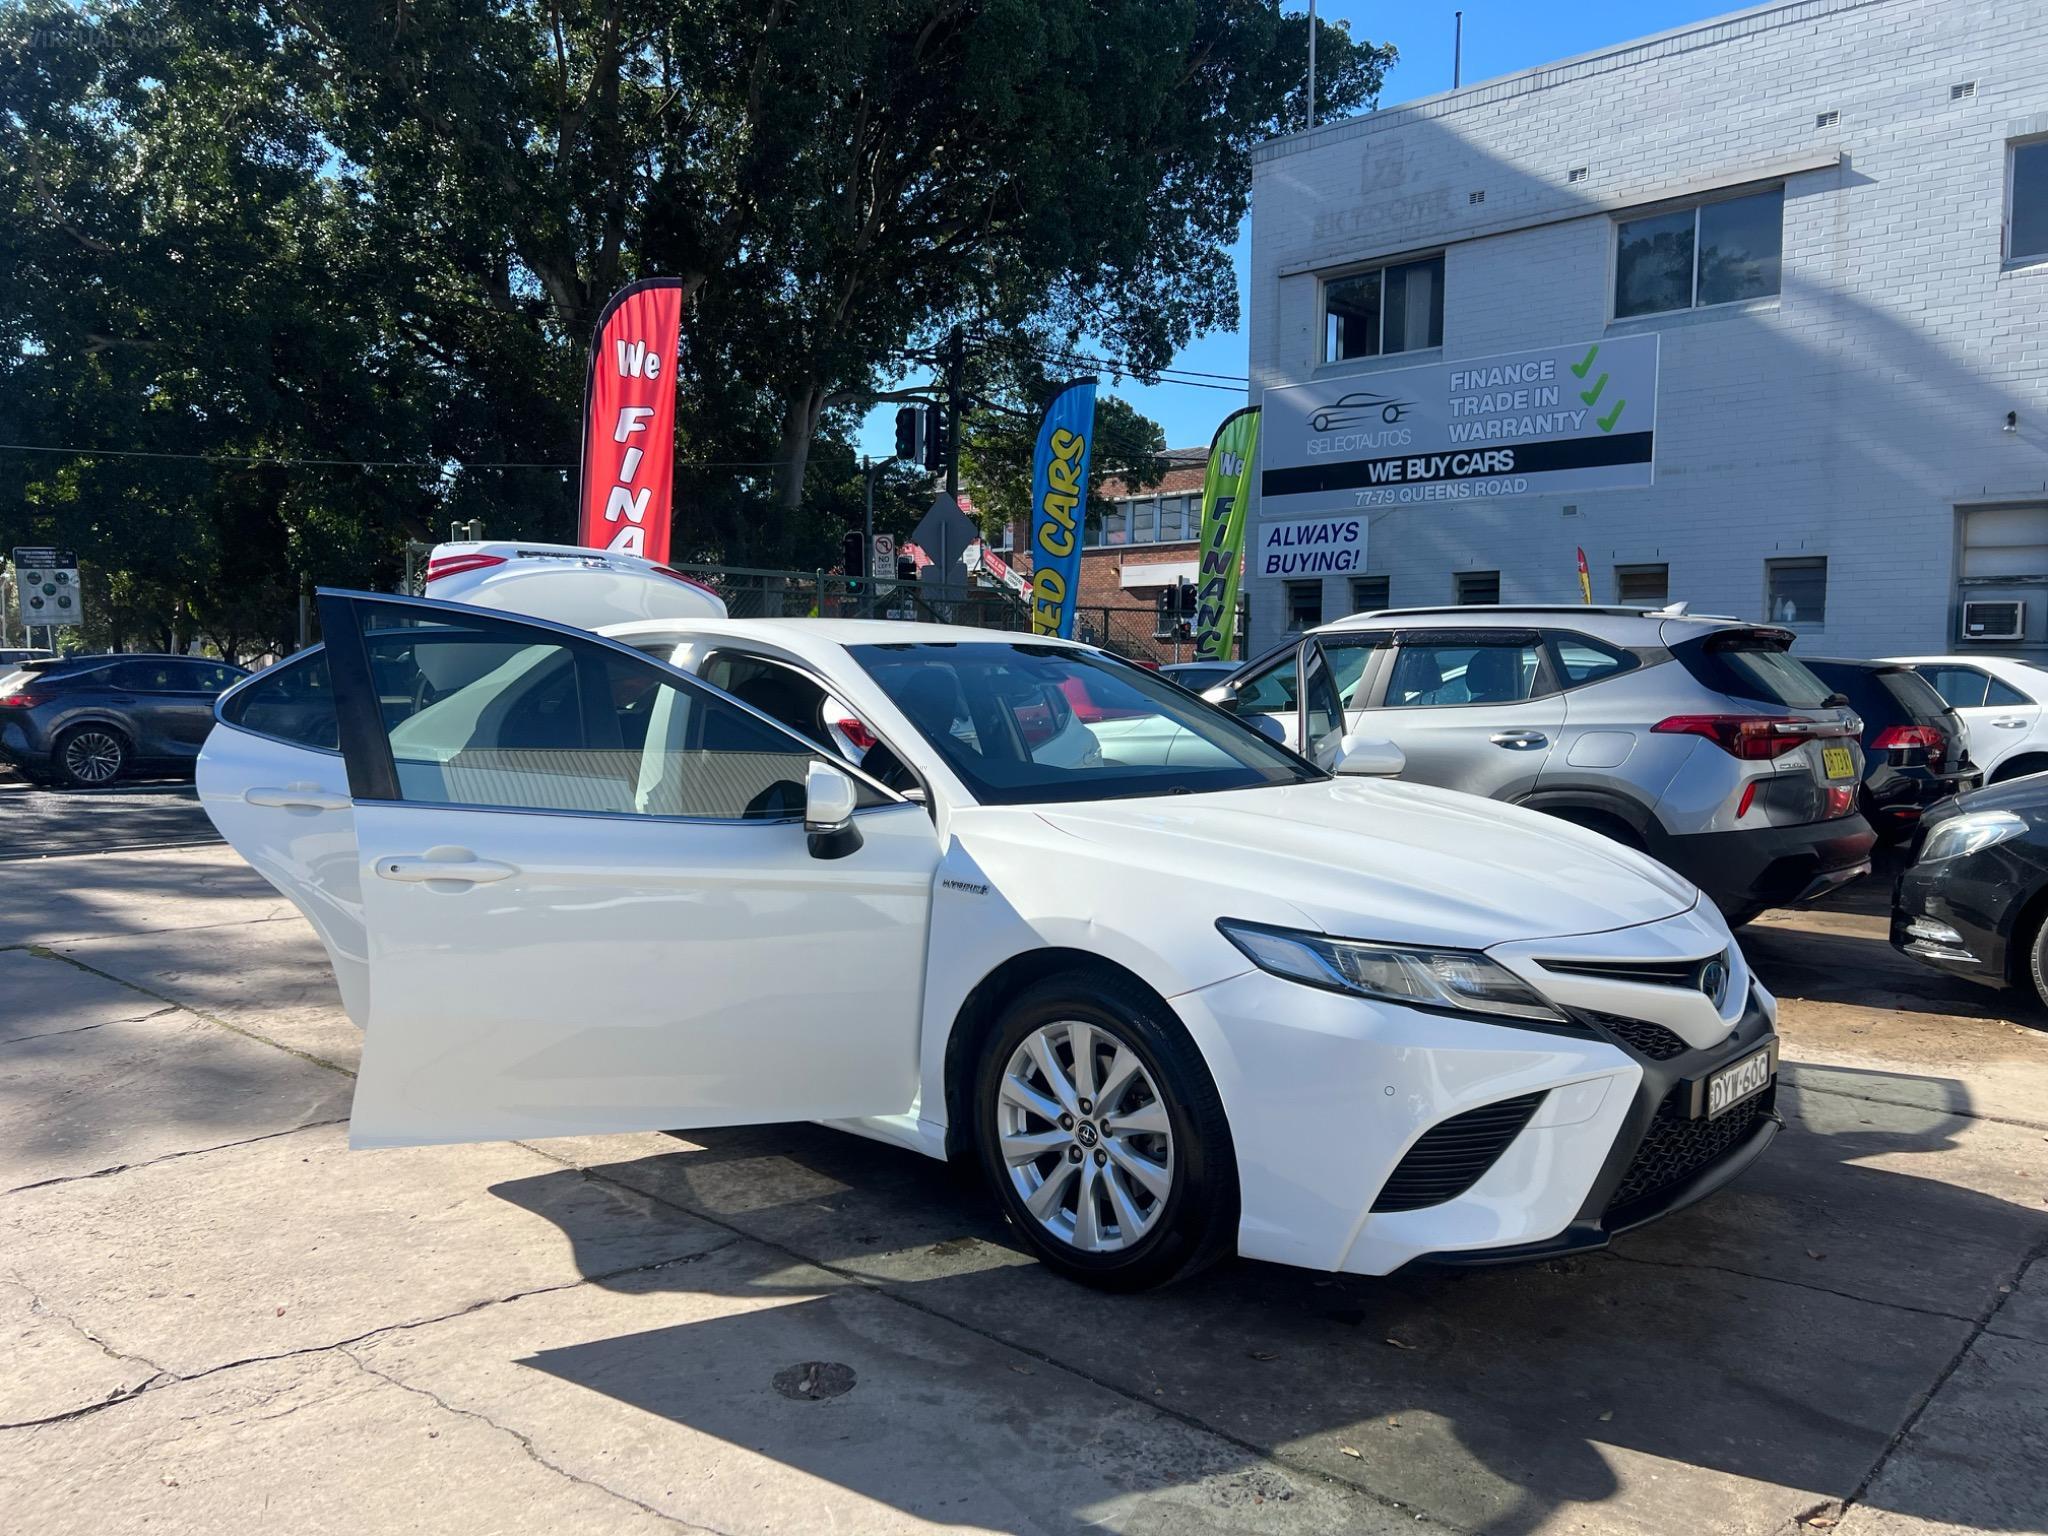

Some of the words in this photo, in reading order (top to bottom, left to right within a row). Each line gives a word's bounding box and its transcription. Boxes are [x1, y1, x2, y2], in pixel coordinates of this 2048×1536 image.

[616, 339, 661, 380] We
[1450, 360, 1555, 392] FINANCE
[1450, 389, 1529, 417] TRADE
[1533, 386, 1560, 408] IN
[1306, 428, 1412, 455] ISELECTAUTOS
[1449, 409, 1587, 443] WARRANTY
[1219, 451, 1244, 477] We
[1368, 460, 1402, 483] WE
[1406, 455, 1452, 480] BUY
[1452, 449, 1515, 475] CARS
[1037, 427, 1086, 558] CARS
[1354, 489, 1396, 506] 77-79
[1399, 482, 1471, 504] QUEENS
[1474, 477, 1528, 497] ROAD
[1266, 521, 1360, 547] ALWAYS
[878, 555, 890, 563] NO
[1265, 549, 1360, 574] BUYING!
[1197, 497, 1236, 661] FINANC
